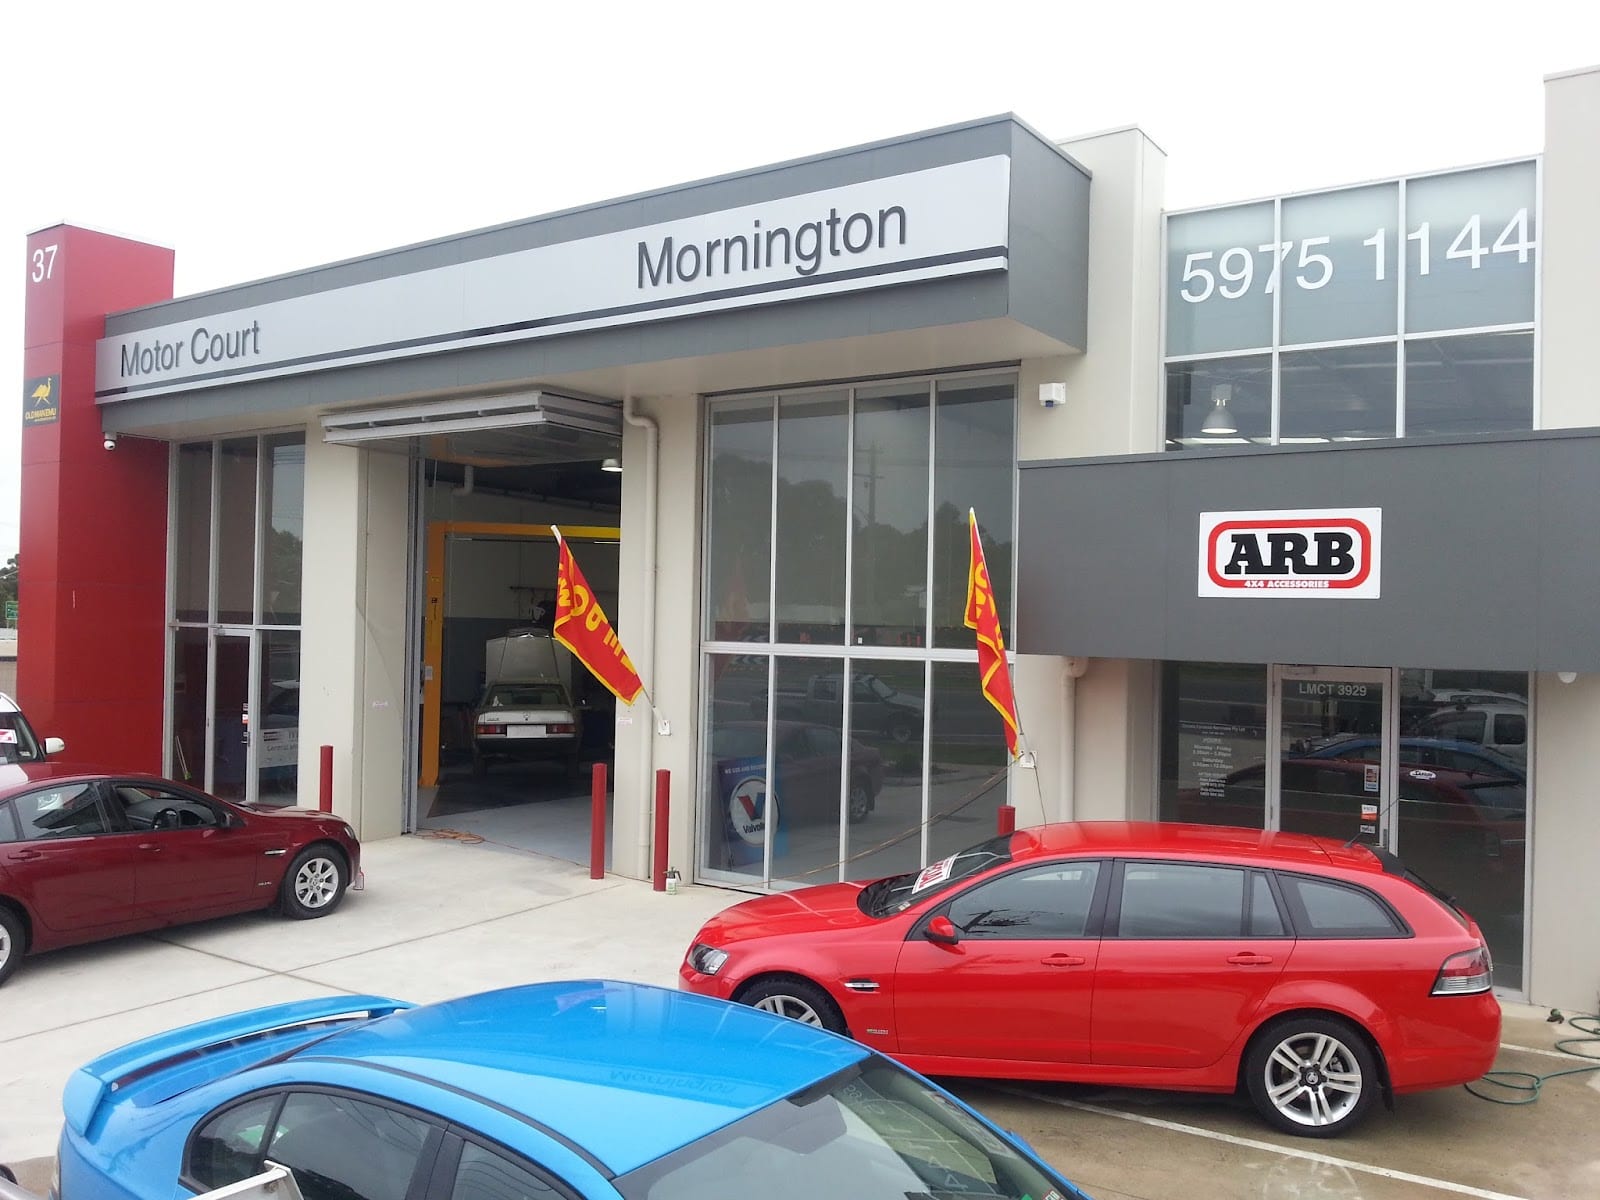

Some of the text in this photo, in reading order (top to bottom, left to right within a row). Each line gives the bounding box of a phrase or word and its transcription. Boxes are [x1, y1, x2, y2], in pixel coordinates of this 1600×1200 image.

[31, 244, 58, 284] 37
[637, 204, 907, 290] Mornington
[1179, 207, 1536, 304] 5975 1144
[120, 319, 261, 378] Motor Court
[1224, 531, 1356, 575] ARB
[1243, 580, 1330, 589] 4X4 ACCESSORIES
[1299, 683, 1367, 697] LMCT 3929
